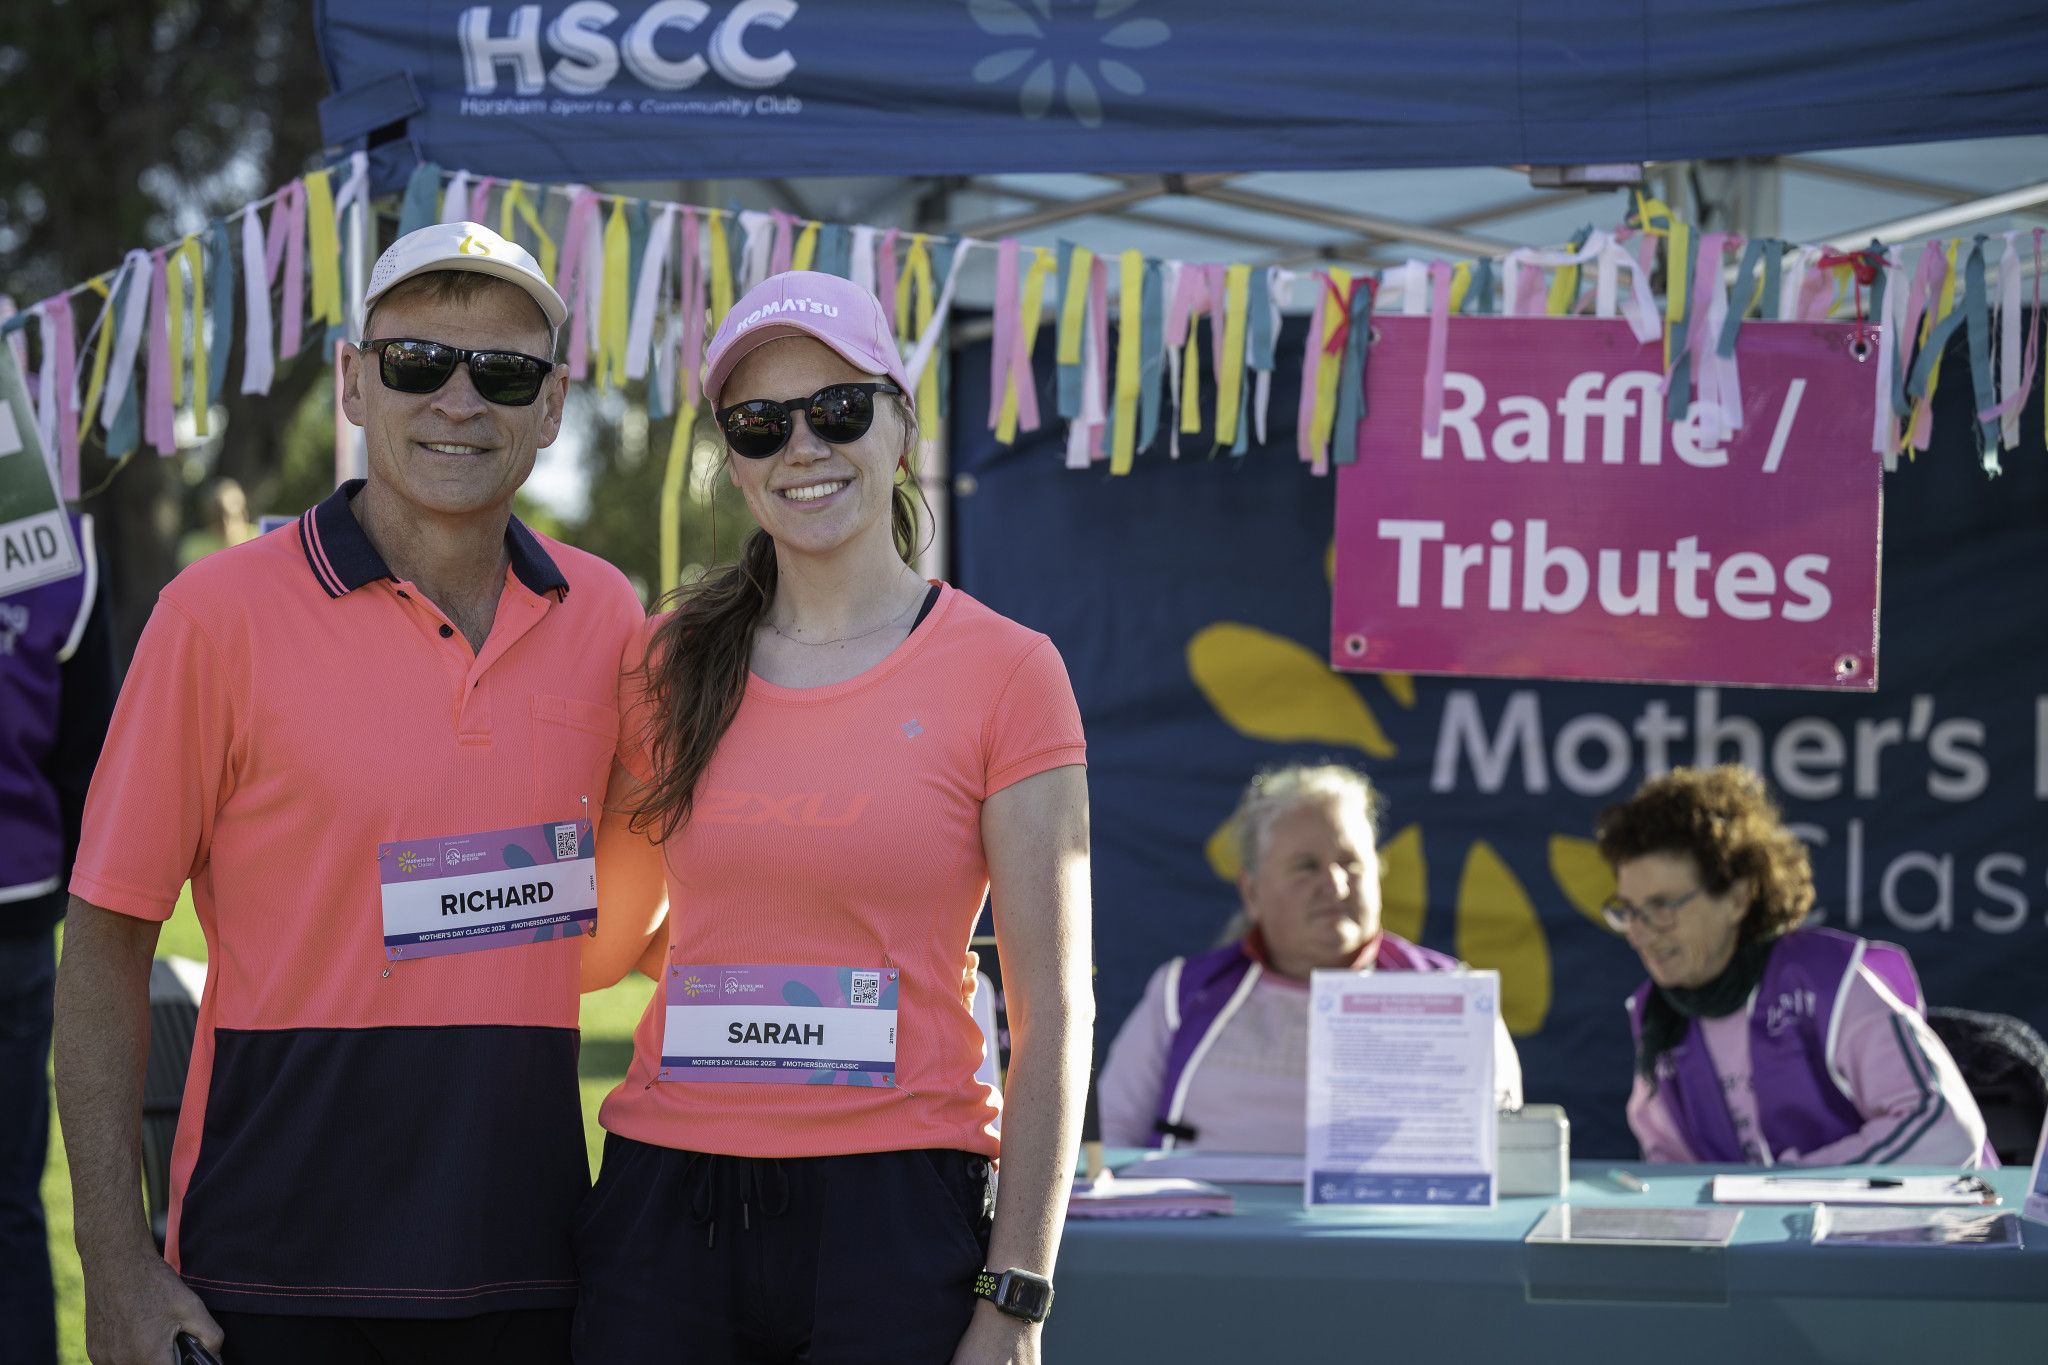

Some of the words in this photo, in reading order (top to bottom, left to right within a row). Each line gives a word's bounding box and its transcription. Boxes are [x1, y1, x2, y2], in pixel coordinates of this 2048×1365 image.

[459, 0, 800, 96] HSCC
[755, 94, 803, 115] Club
[736, 297, 839, 334] KOMATSU
[1421, 370, 1734, 468] Raffle
[4, 525, 58, 573] AID
[1377, 518, 1833, 623] Tributes
[440, 880, 554, 917] RICHARD
[419, 931, 452, 942] MOTHER'S
[452, 929, 465, 939] DAY
[465, 925, 491, 937] CLASSIC
[491, 923, 506, 934] 2025
[510, 914, 572, 931] #MOTHERSDAYCLASSIC
[727, 1021, 825, 1046] SARAH
[691, 1059, 720, 1067] MOTHER'S
[720, 1059, 734, 1067] DAY
[734, 1059, 760, 1068] CLASSIC
[760, 1060, 777, 1068] 2025
[782, 1060, 860, 1070] #MOTHERSDAYCLASSIC
